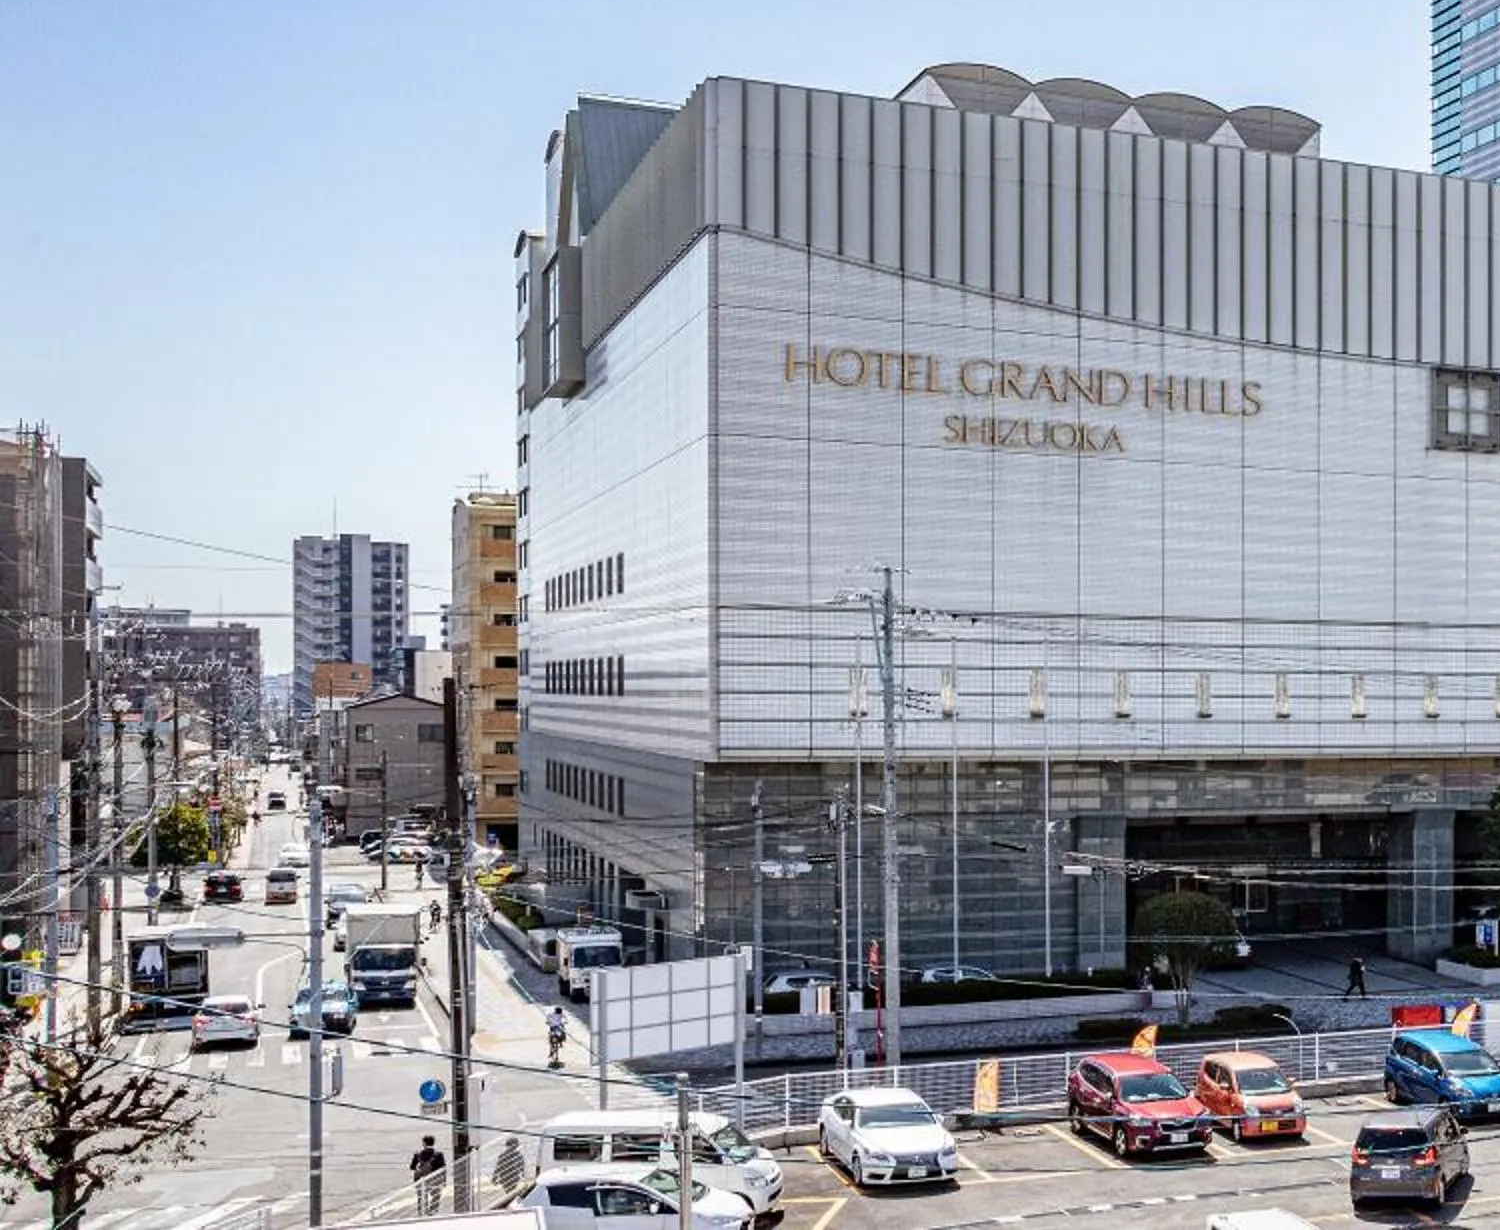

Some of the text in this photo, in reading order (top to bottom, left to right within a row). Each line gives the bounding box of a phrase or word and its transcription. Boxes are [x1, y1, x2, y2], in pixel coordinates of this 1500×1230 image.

[785, 342, 1264, 417] HOTEL GRAND HILLS
[942, 414, 1125, 452] SHIZUOKA
